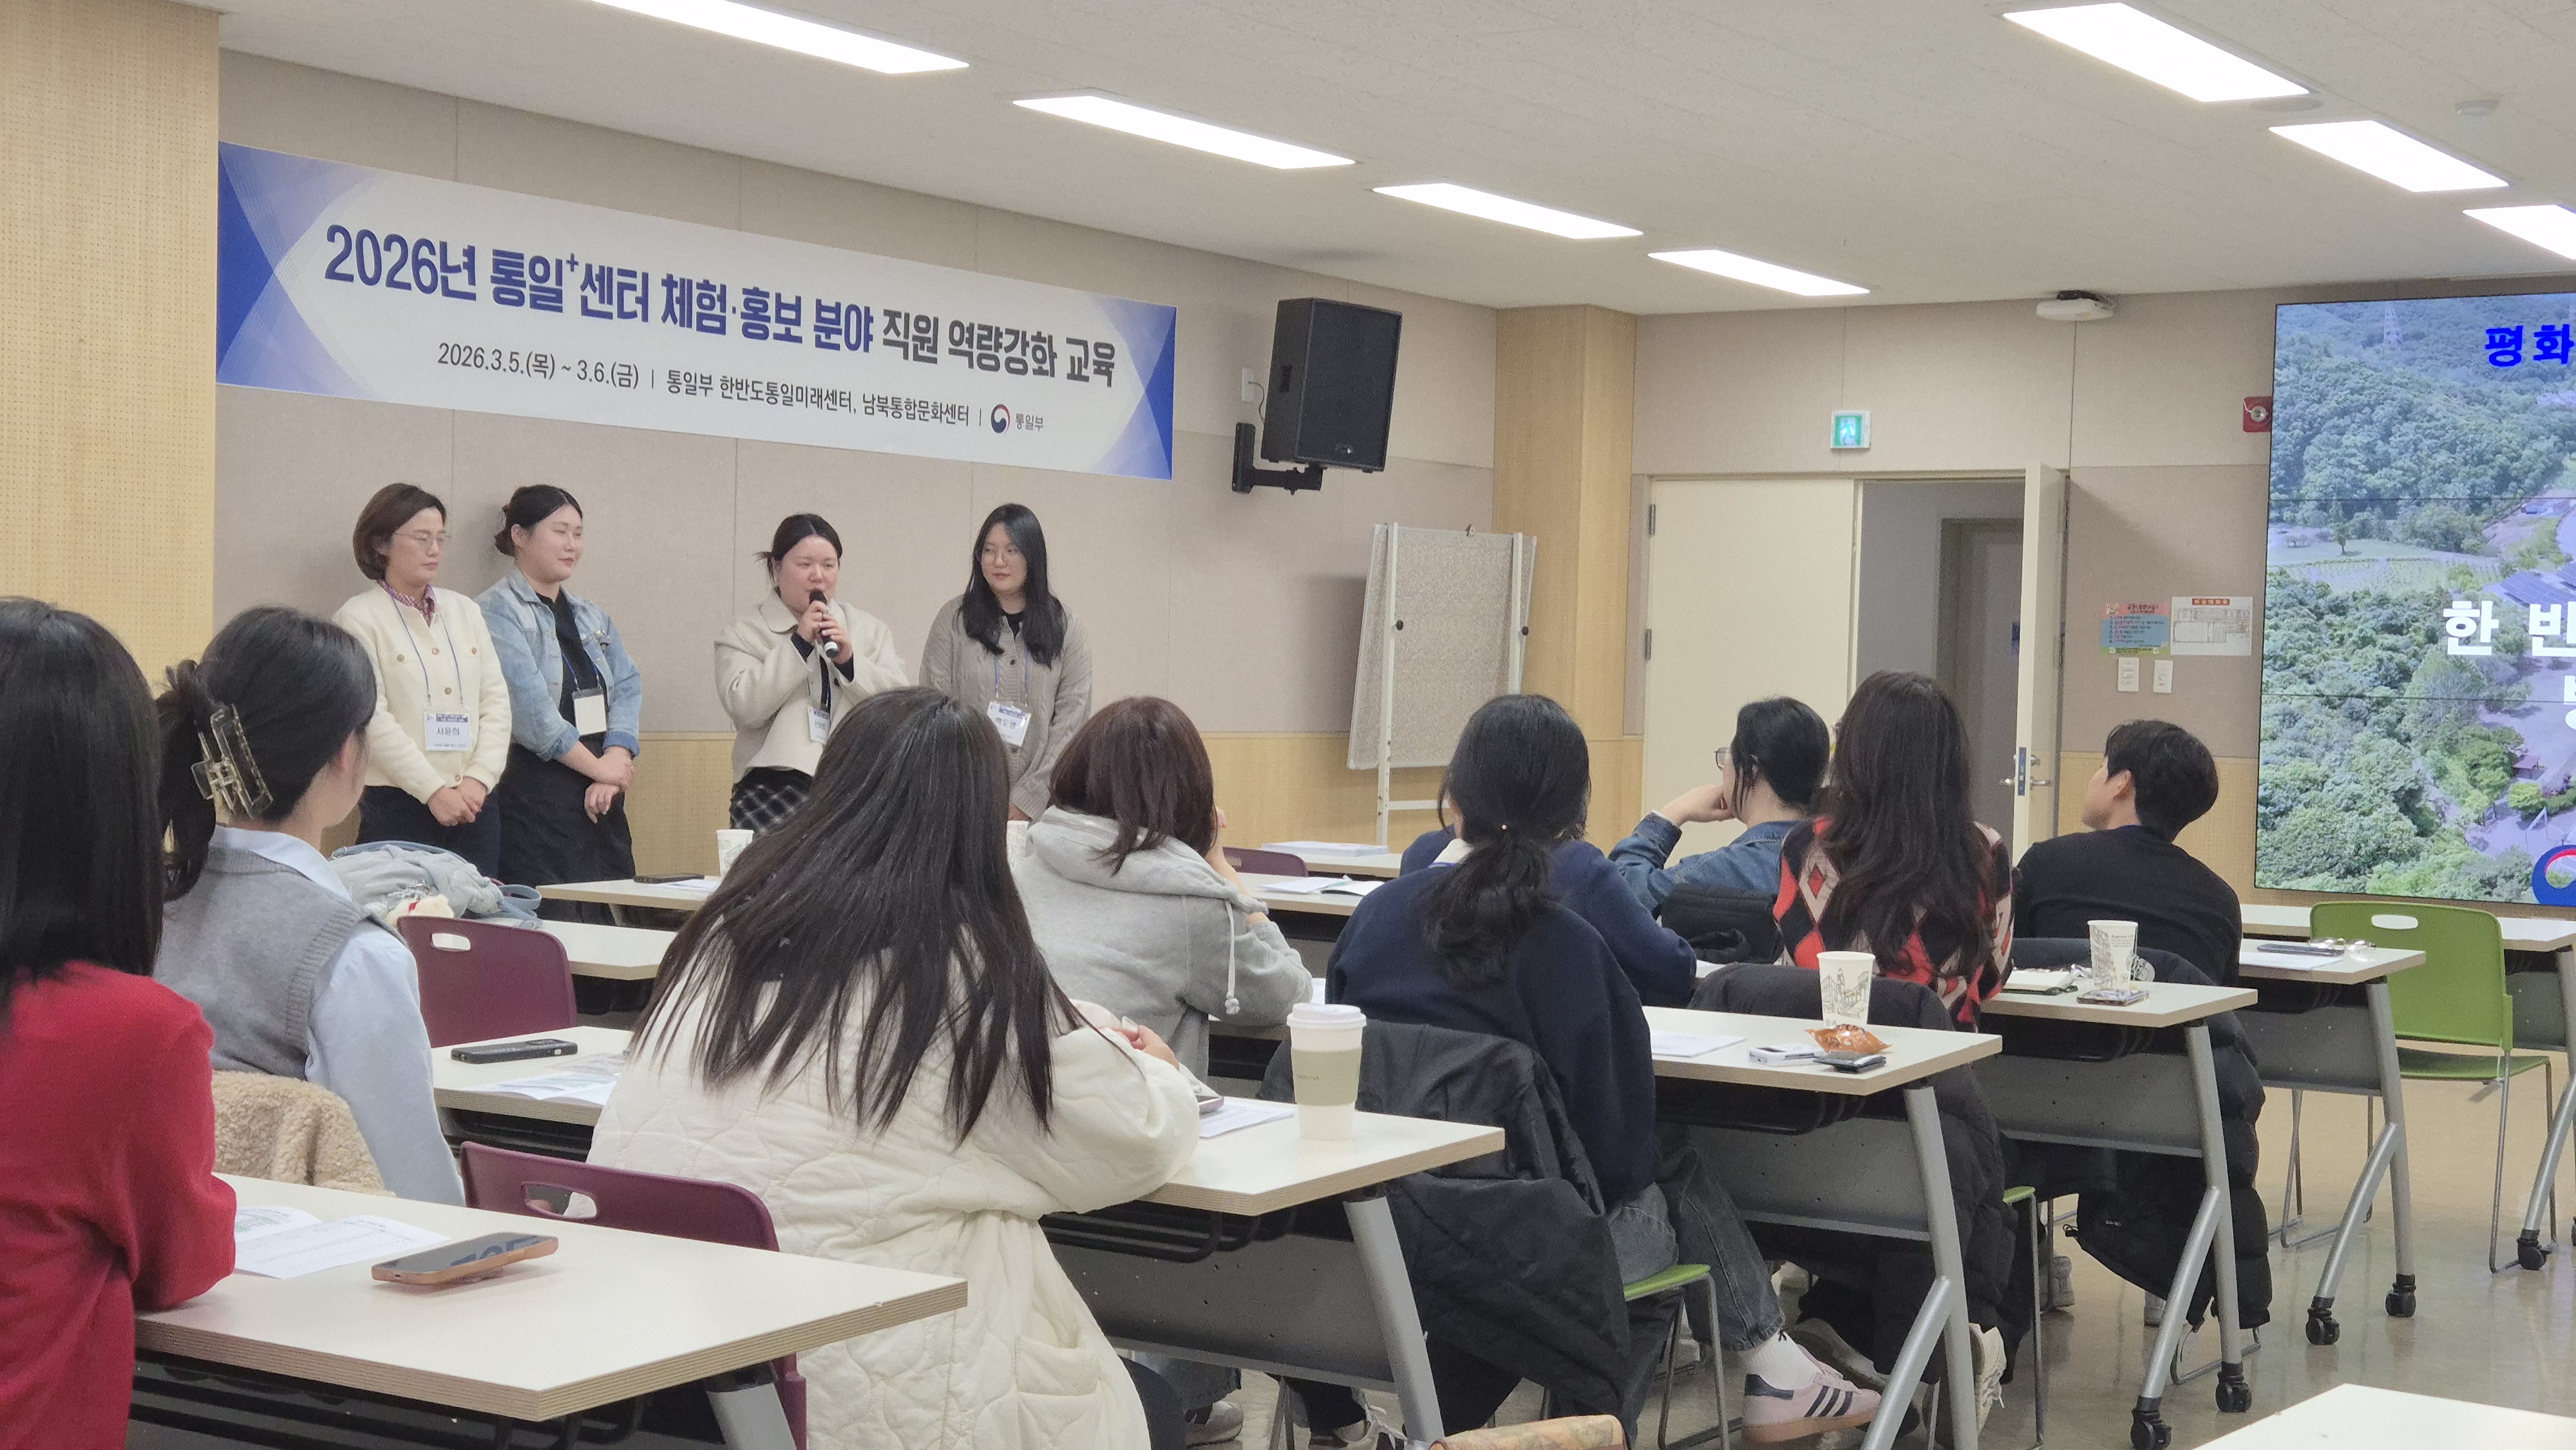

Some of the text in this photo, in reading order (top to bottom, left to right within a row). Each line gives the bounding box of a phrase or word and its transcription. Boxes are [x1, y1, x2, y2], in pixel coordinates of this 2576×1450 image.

[325, 224, 477, 301] 2026년
[813, 298, 874, 353] 분야
[882, 308, 939, 364] 직원
[948, 320, 1057, 377] 역량강화
[1066, 337, 1115, 388] 교육
[437, 343, 555, 380] 2026.3.5.(목)
[576, 359, 639, 390] 3.6.(금)
[667, 370, 714, 397] 통일부
[719, 375, 857, 415] 한반도통일미래센터,
[863, 393, 969, 426] 남북통합문화센터
[1016, 413, 1044, 431] 통일부
